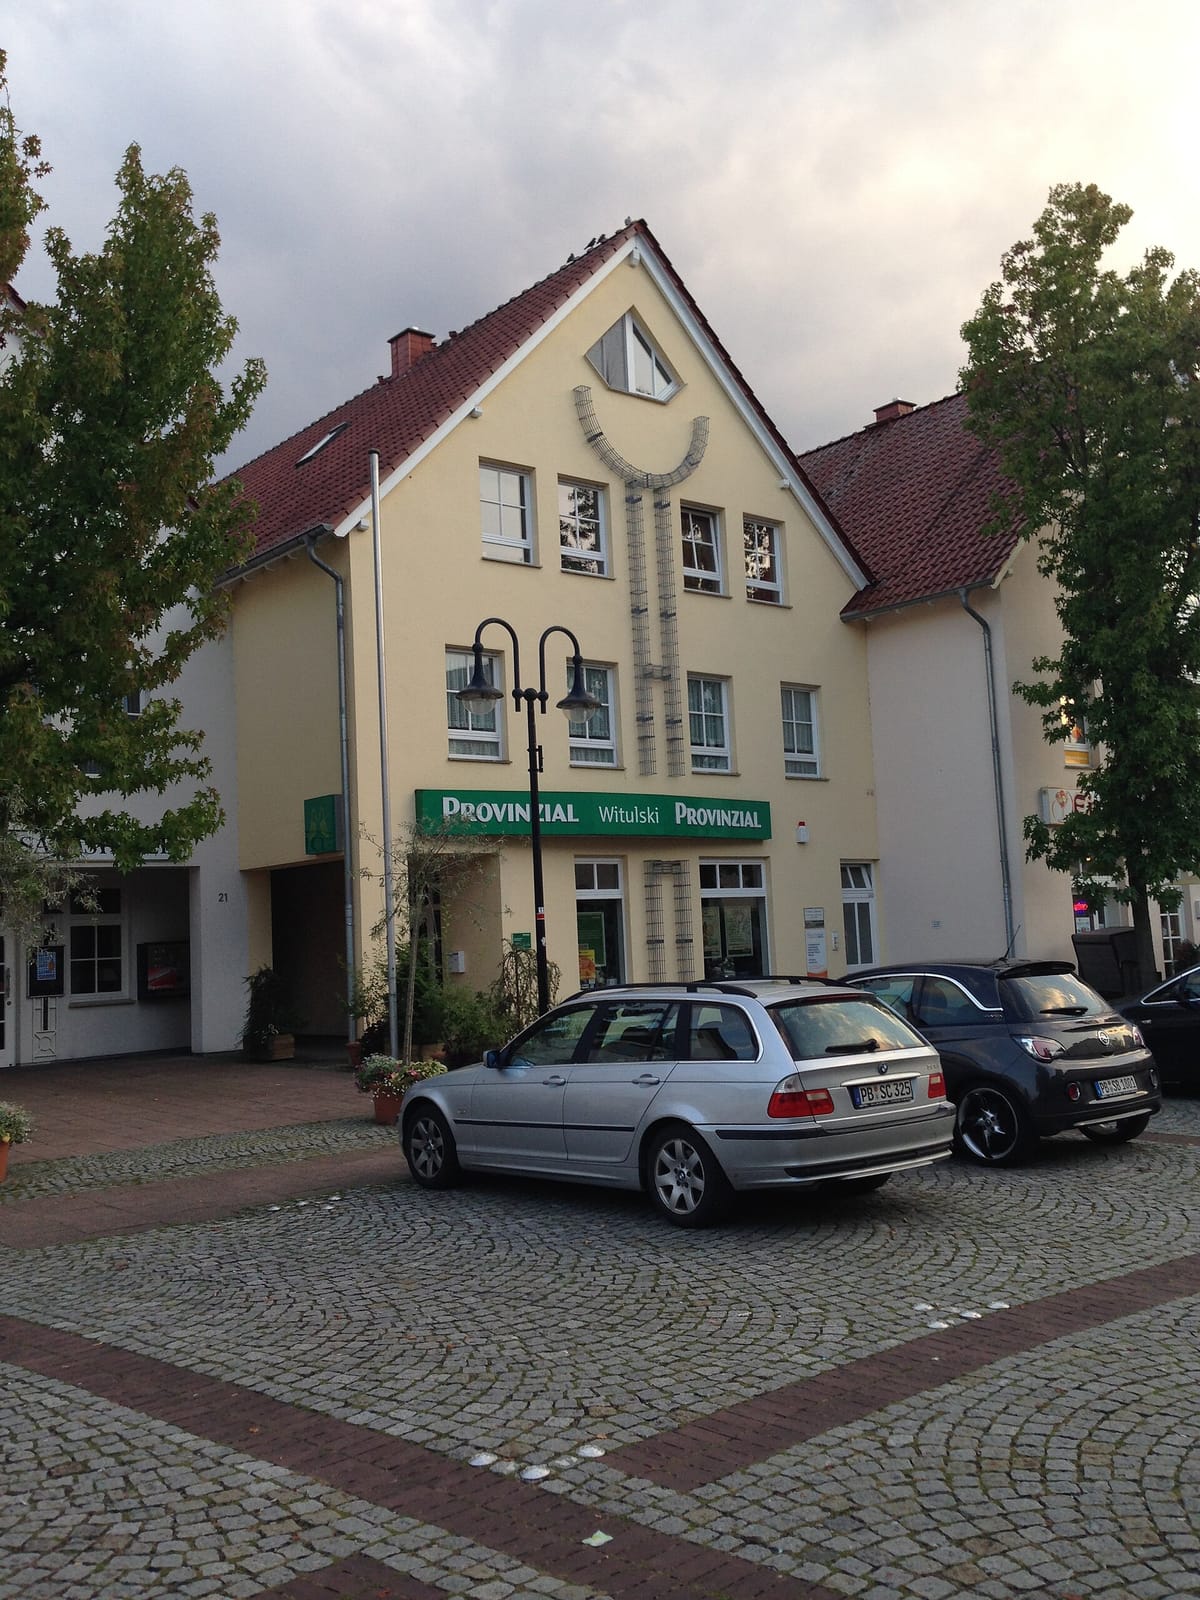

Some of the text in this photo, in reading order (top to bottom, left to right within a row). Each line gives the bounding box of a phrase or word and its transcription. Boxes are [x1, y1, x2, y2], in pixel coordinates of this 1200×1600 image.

[598, 806, 660, 824] Witulski
[674, 802, 762, 828] PROVINZIAL
[218, 892, 228, 903] 21
[860, 1081, 911, 1102] PB SC 325
